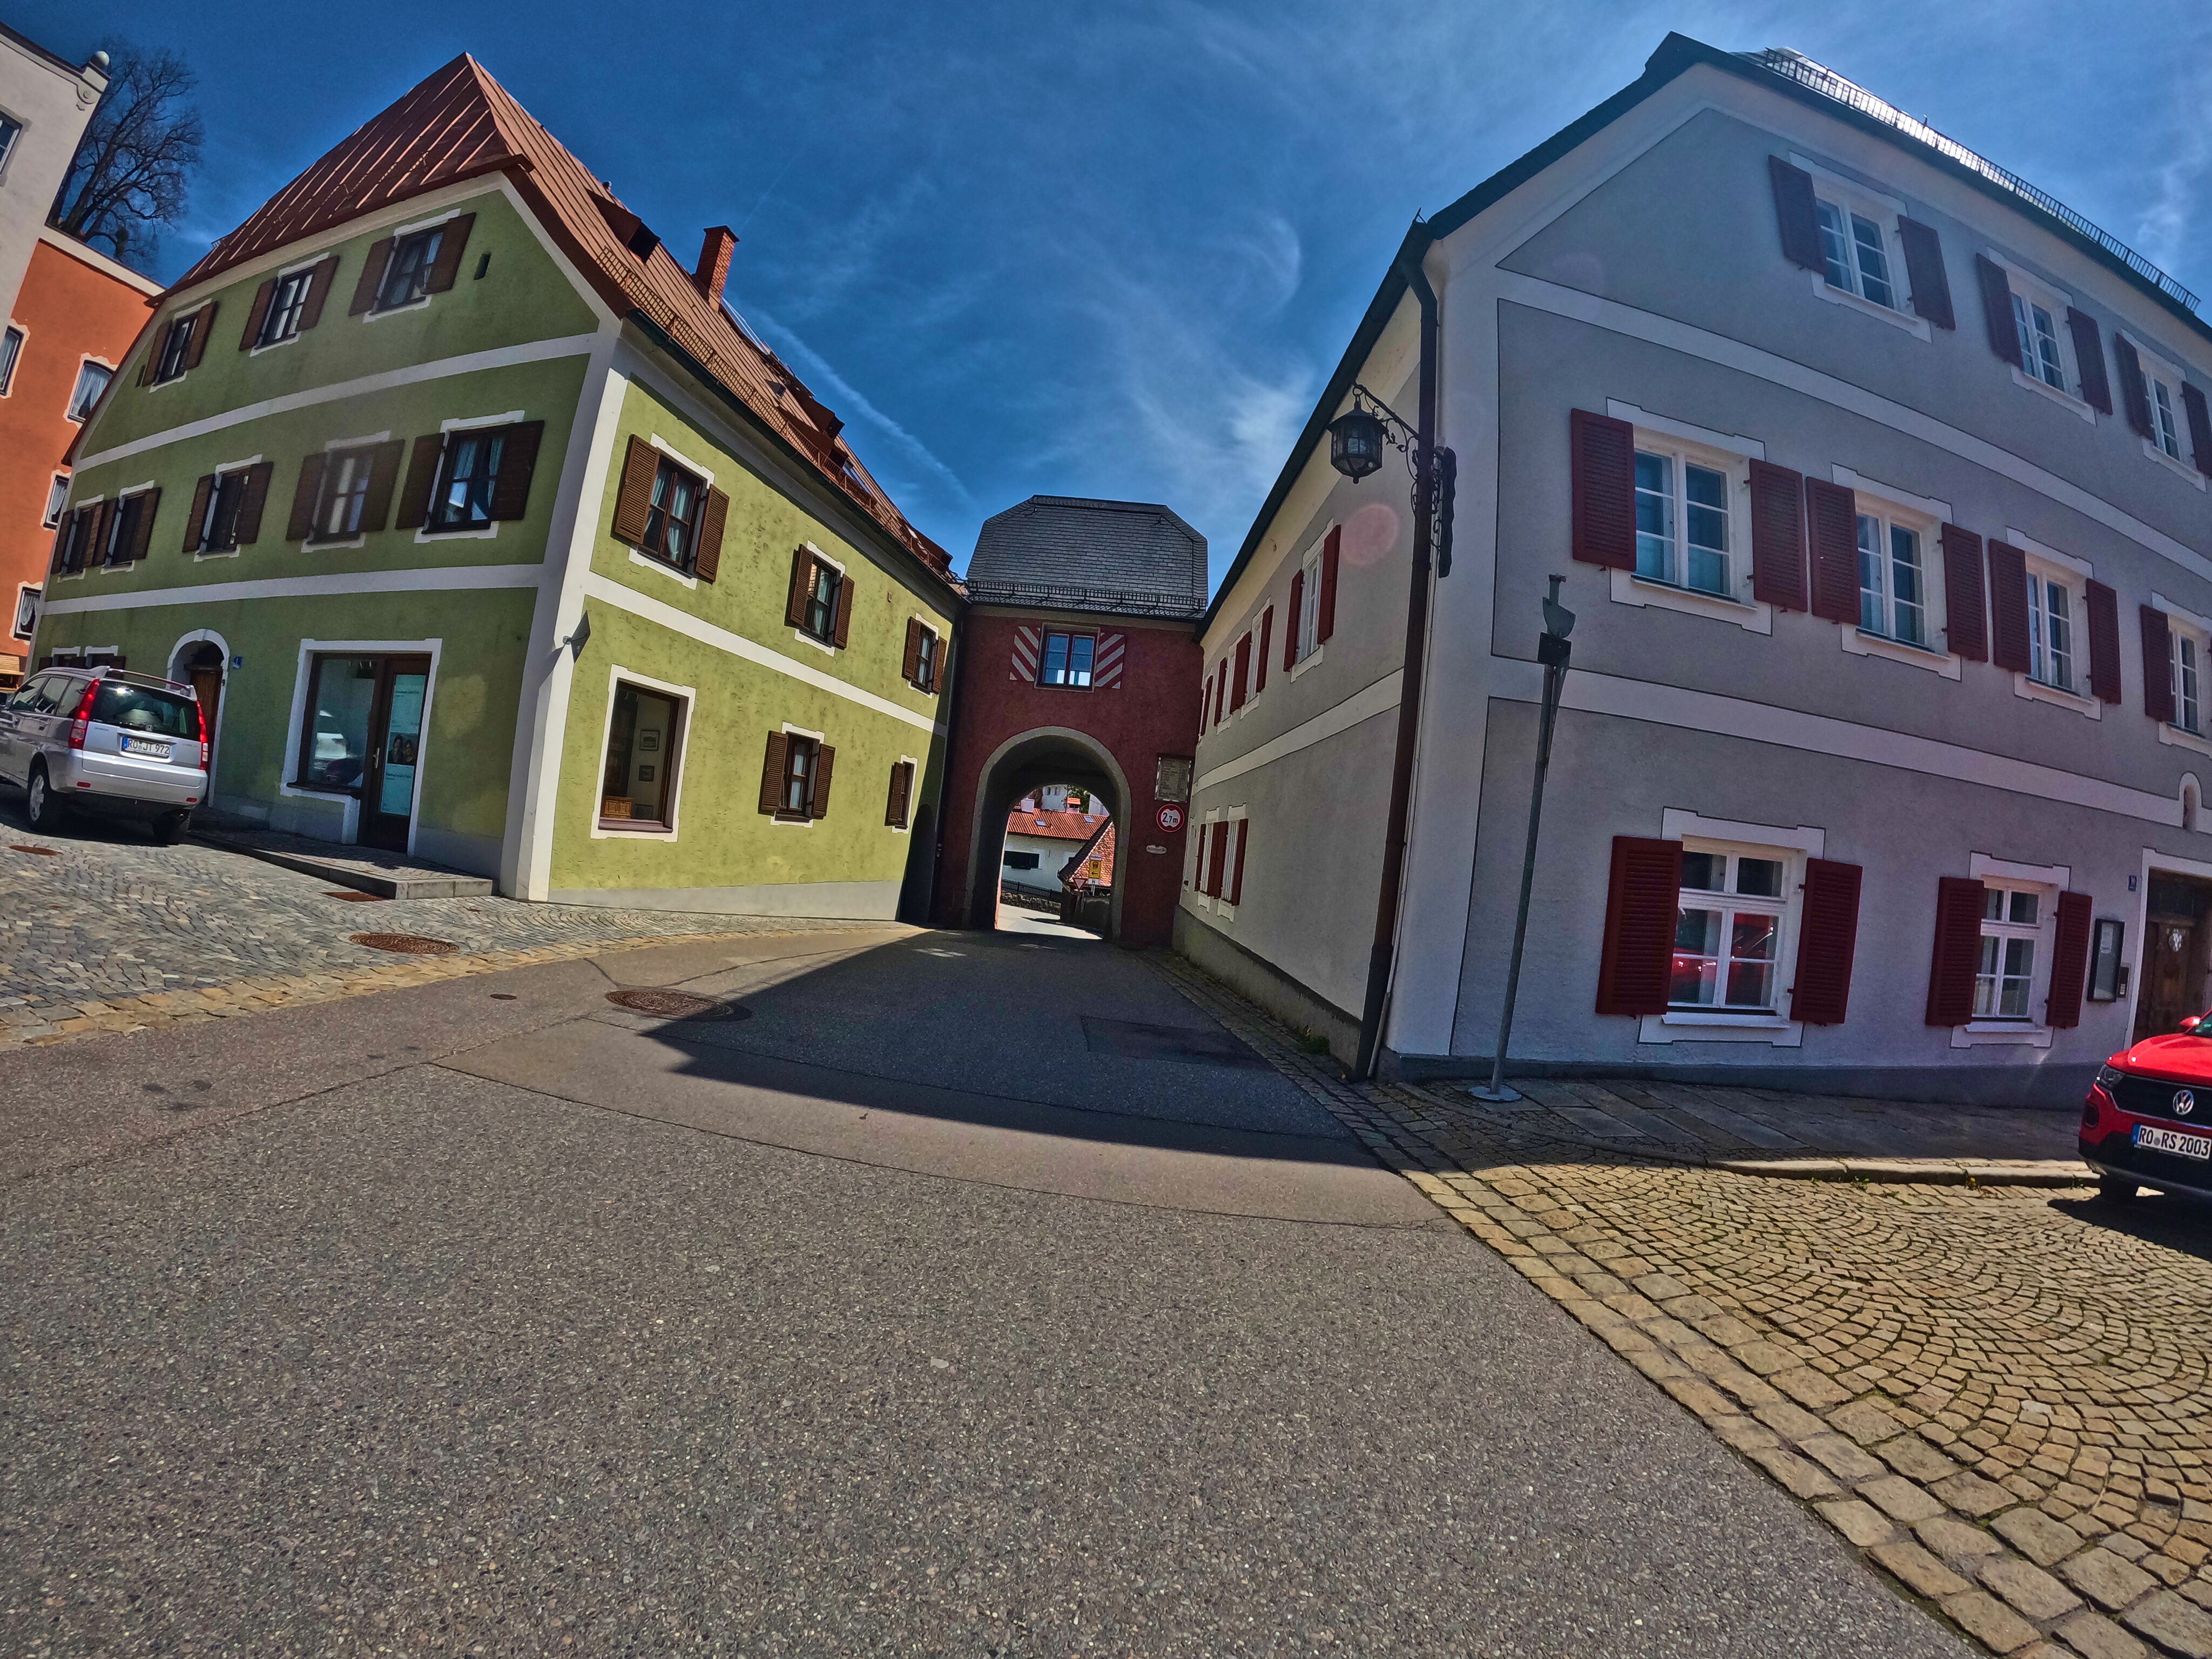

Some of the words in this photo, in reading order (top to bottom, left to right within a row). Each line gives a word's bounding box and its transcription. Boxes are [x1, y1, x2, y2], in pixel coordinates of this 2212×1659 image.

[128, 739, 138, 748] RO
[156, 744, 170, 754] 972
[2138, 1128, 2154, 1144] RO
[2161, 1132, 2177, 1150] RS
[2178, 1136, 2210, 1156] 2003
